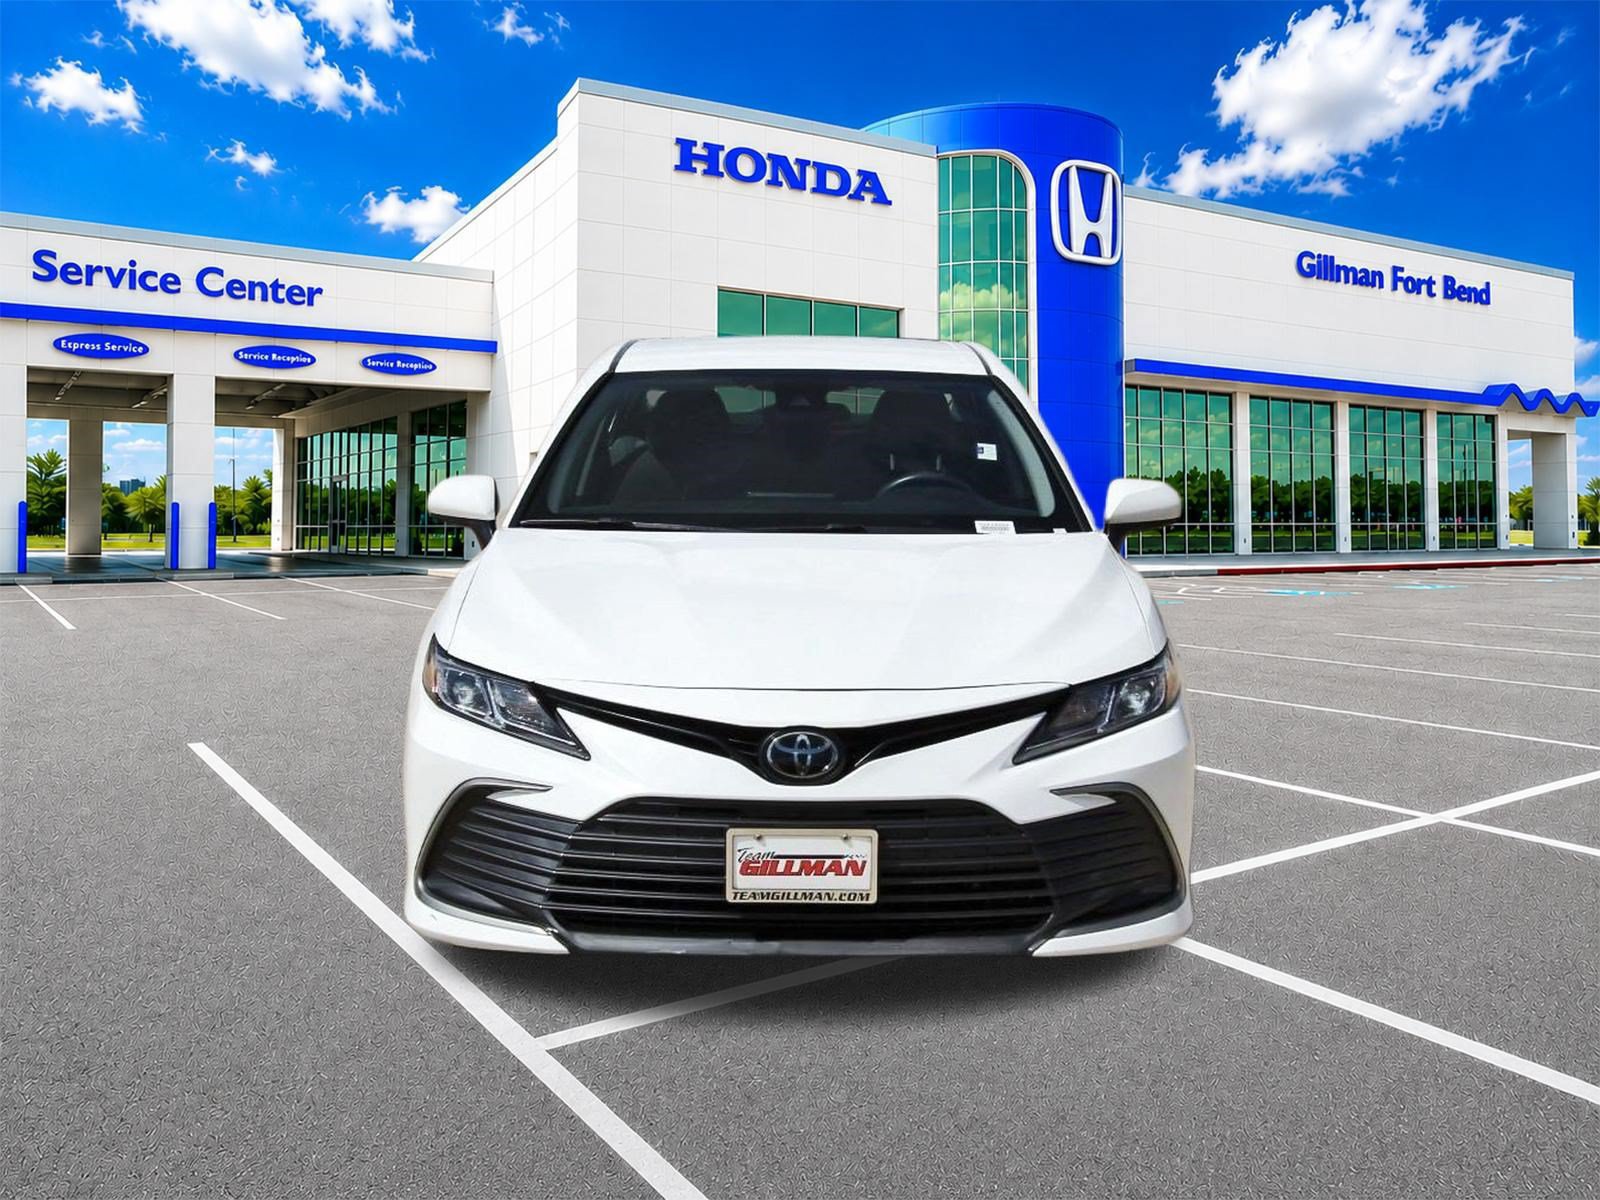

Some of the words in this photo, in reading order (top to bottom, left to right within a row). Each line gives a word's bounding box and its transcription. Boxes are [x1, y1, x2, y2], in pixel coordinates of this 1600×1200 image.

[674, 137, 893, 206] HONDA
[32, 249, 182, 294] Service
[195, 266, 324, 307] Center
[1296, 250, 1385, 290] Gillman
[1391, 265, 1437, 299] Fort
[1443, 274, 1491, 306] Bend
[104, 342, 145, 354] Service
[238, 351, 270, 362] Service
[367, 358, 395, 369] Service
[737, 848, 776, 863] Team
[739, 859, 867, 876] GILLMAN
[732, 891, 870, 902] TEAMGILLMAN.COM
